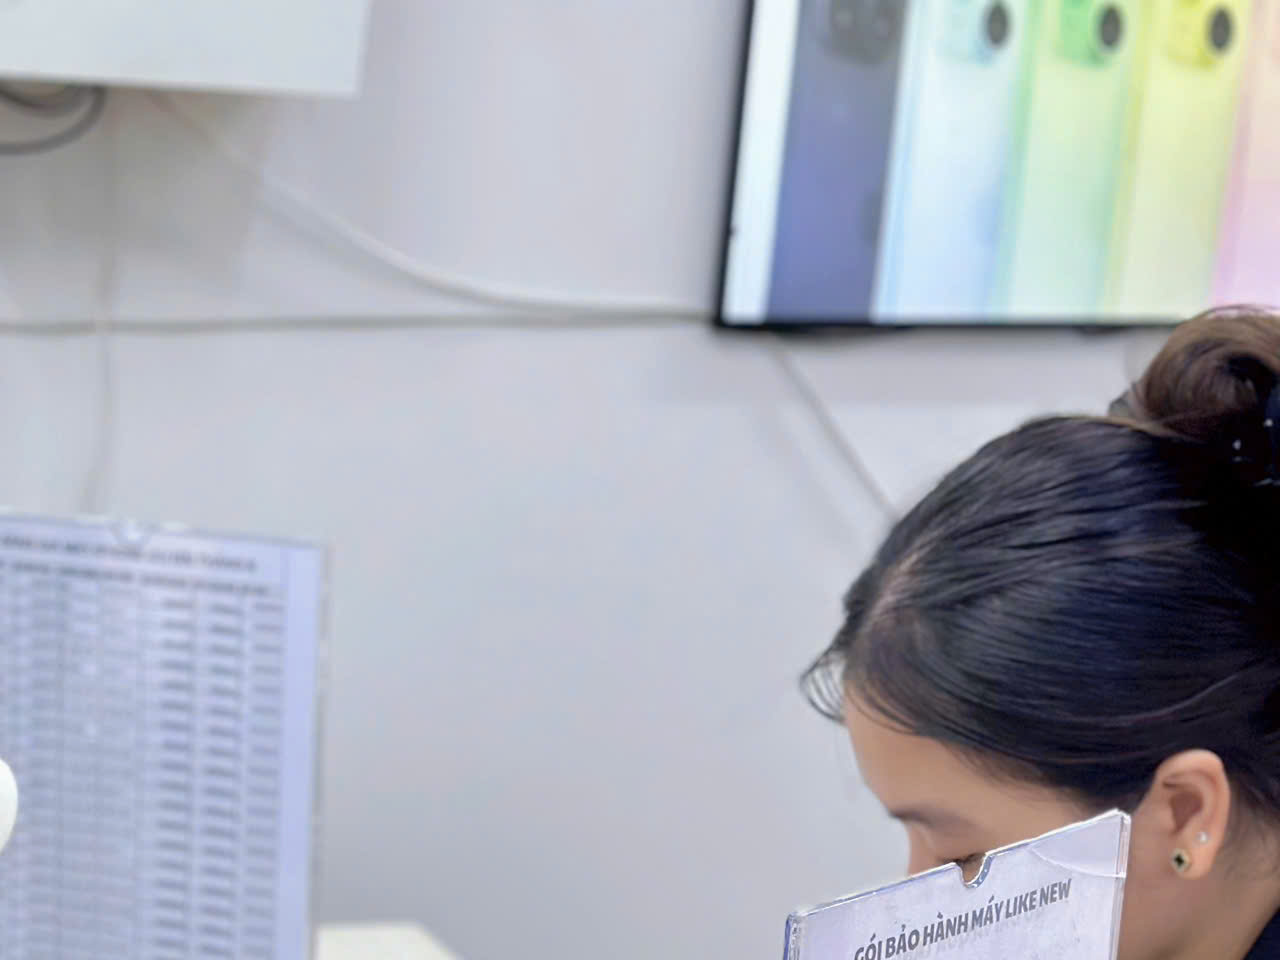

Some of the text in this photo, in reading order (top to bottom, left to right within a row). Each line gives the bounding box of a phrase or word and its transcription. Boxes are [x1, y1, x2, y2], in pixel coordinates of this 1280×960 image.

[885, 924, 920, 958] BẢO
[923, 911, 968, 946] HÀNH
[971, 895, 1003, 930] MÁY
[1005, 889, 1036, 919] LIKE
[1039, 878, 1072, 907] NEW
